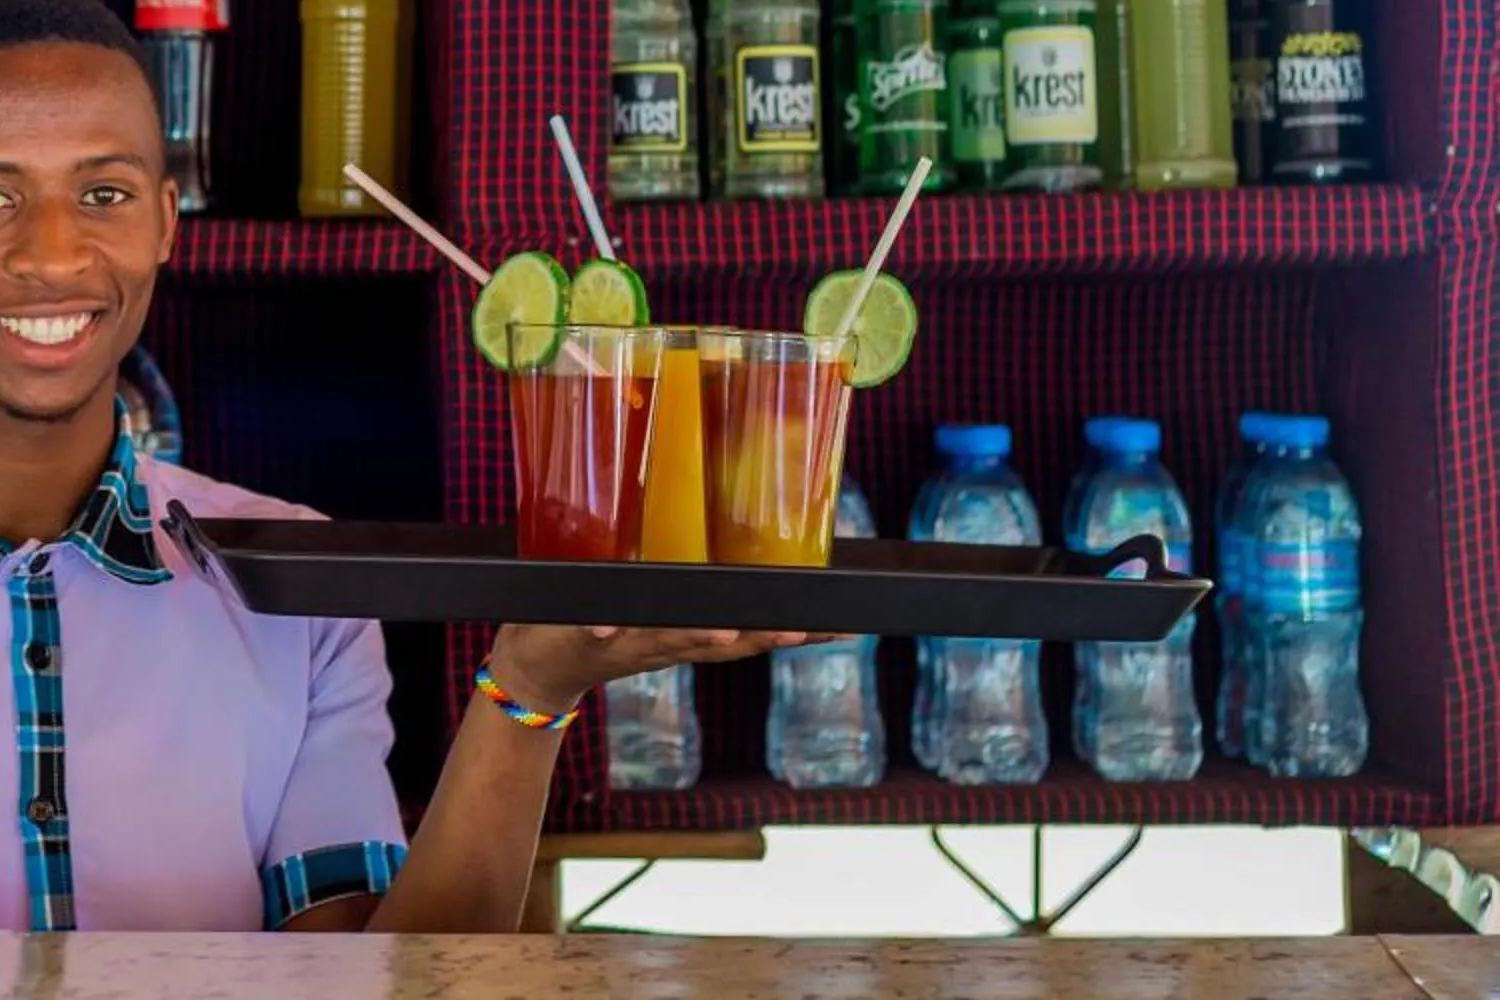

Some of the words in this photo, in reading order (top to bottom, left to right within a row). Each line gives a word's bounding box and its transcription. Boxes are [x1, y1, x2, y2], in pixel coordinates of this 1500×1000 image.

[745, 76, 813, 124] krest
[960, 82, 1004, 129] kre
[1012, 65, 1085, 109] krest
